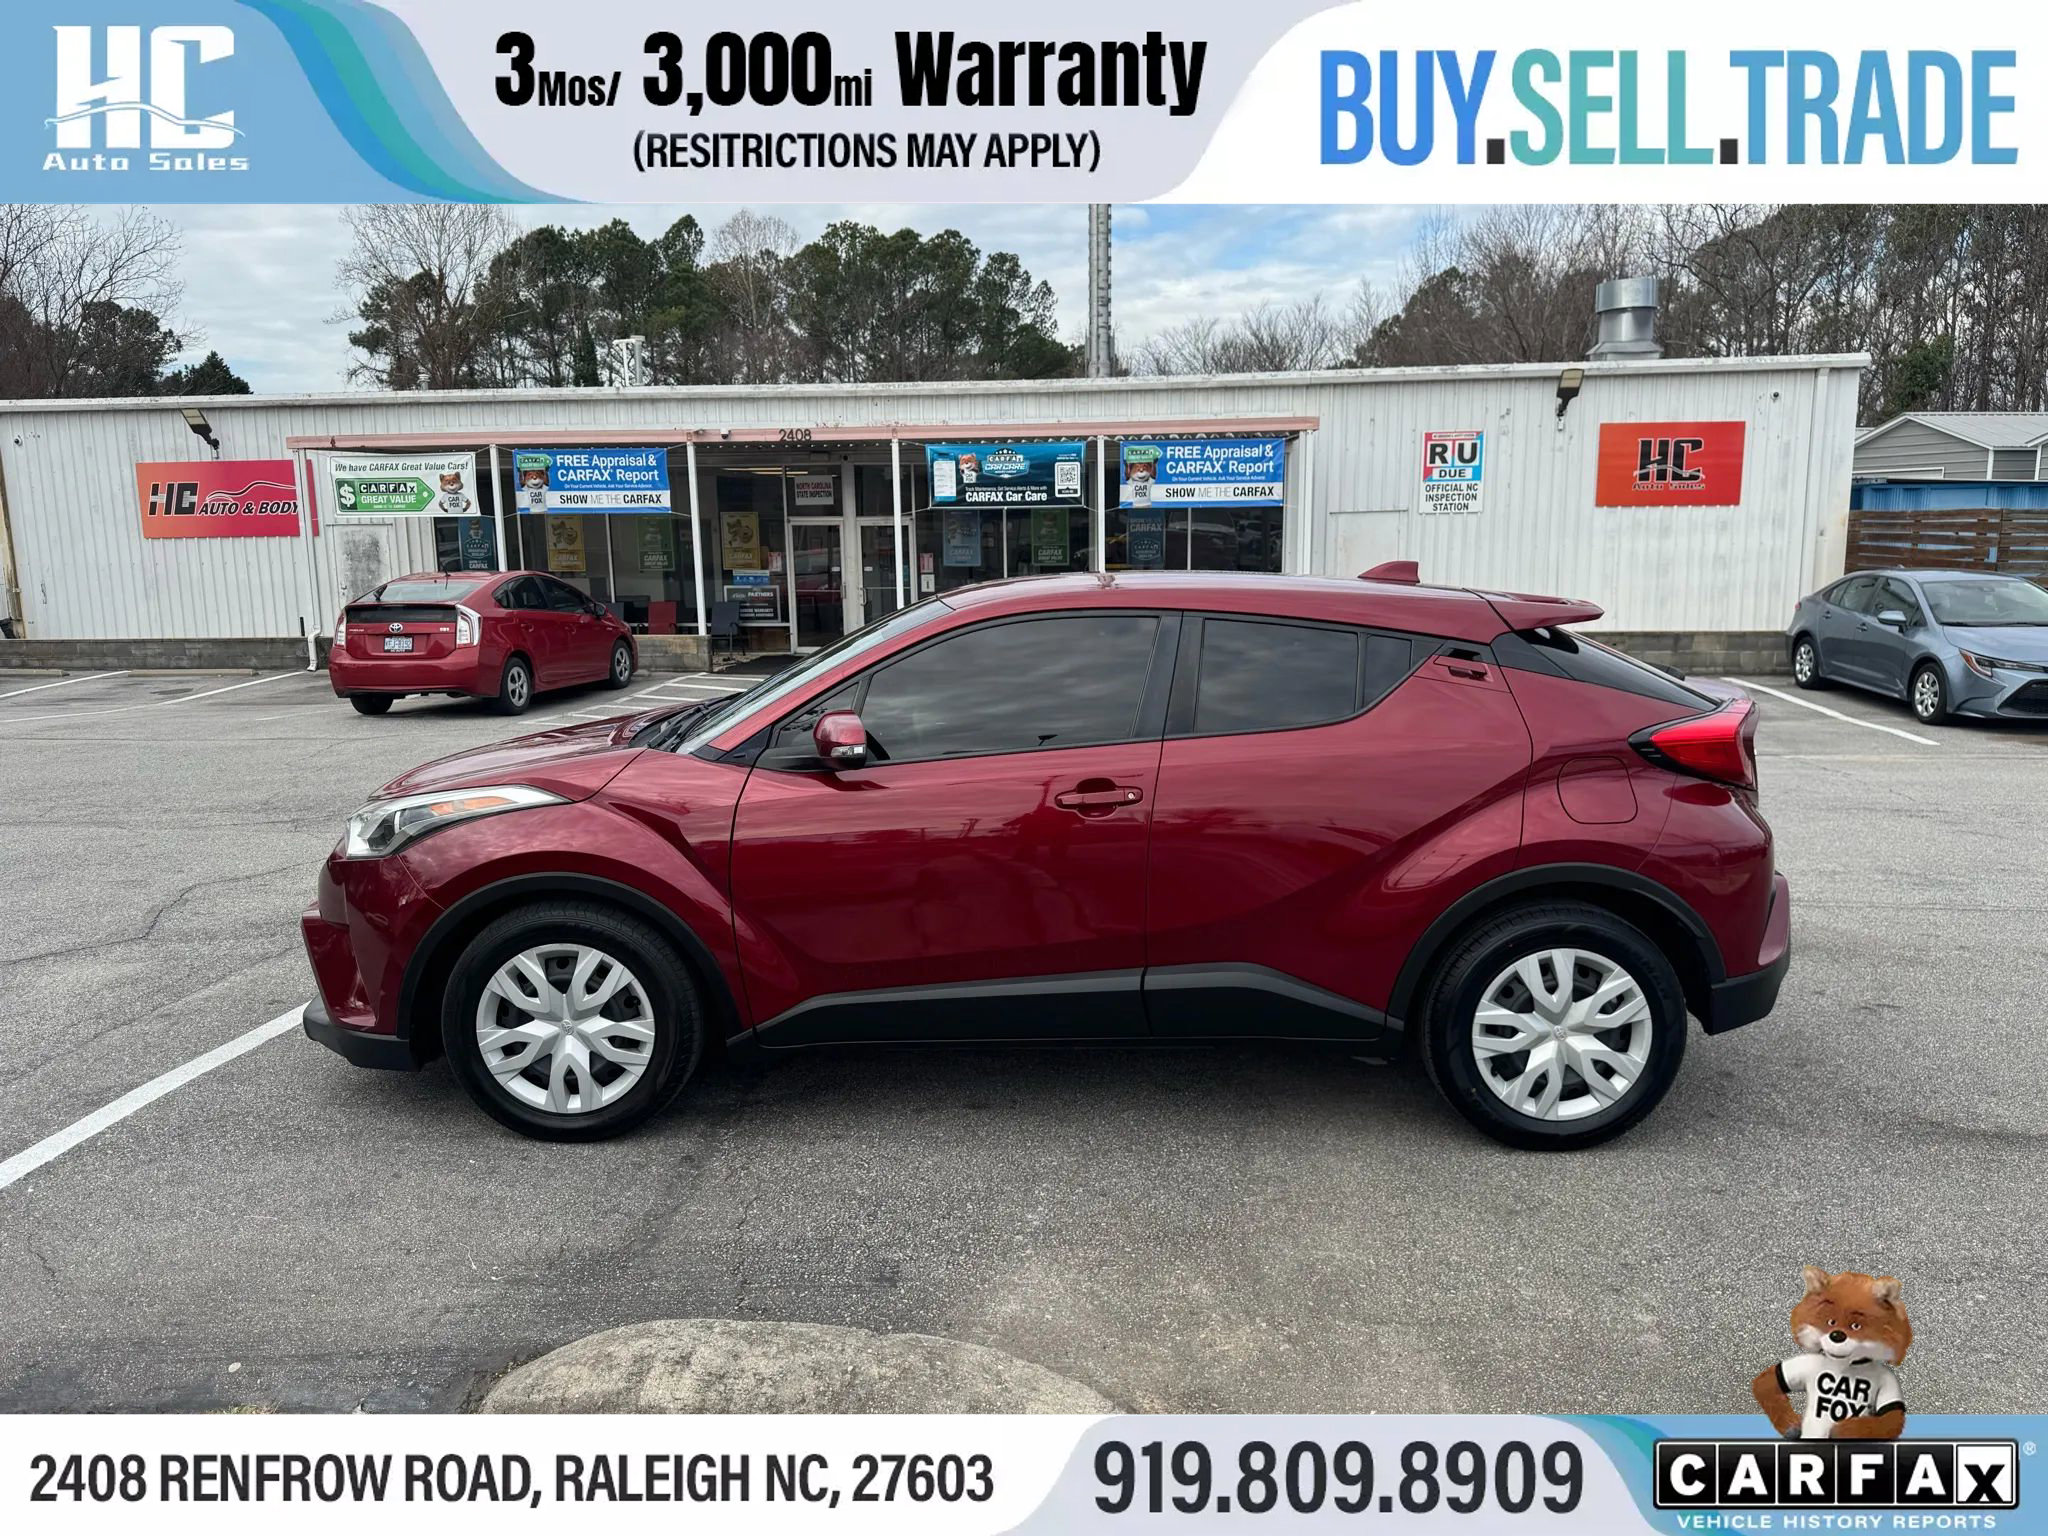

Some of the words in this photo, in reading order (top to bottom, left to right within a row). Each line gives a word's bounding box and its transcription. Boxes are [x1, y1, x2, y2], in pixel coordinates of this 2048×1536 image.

[779, 429, 812, 441] 2408
[1166, 446, 1201, 458] FREE
[1203, 444, 1262, 461] Appraisal
[1264, 445, 1274, 457] &
[556, 455, 590, 466] FREE
[592, 454, 646, 470] Appraisal
[648, 454, 656, 466] &
[1636, 438, 1704, 483] HC
[335, 464, 346, 472] We
[349, 464, 367, 472] have
[369, 463, 400, 472] CARFAX
[402, 462, 422, 472] Great
[424, 462, 445, 472] Value
[448, 462, 468, 471] Cars!
[1166, 462, 1223, 474] CARFAX
[1228, 460, 1274, 475] Report
[558, 470, 612, 482] CARFAX
[616, 470, 659, 483] Report
[1438, 469, 1466, 478] DUE
[360, 483, 417, 494] CARFAX
[1166, 488, 1196, 498] SHOW
[1198, 487, 1212, 498] ME
[1215, 487, 1232, 497] THE
[1233, 486, 1274, 496] CARFAX
[1425, 484, 1464, 492] OFFICIAL
[1466, 483, 1478, 492] NC
[149, 482, 199, 516] HC
[362, 495, 389, 504] GREAT
[390, 494, 416, 504] VALUE
[560, 494, 588, 504] SHOW
[590, 494, 603, 504] ME
[606, 494, 622, 504] THE
[624, 494, 662, 504] CARFAX
[966, 492, 1004, 502] CARFAX
[1006, 491, 1022, 502] Car
[1025, 491, 1048, 501] Care
[1425, 493, 1478, 502] INSPECTION
[198, 501, 239, 516] AUTO
[242, 502, 255, 515] &
[257, 501, 298, 515] BODY
[1432, 502, 1469, 512] STATION
[1130, 524, 1162, 532] CARFAX
